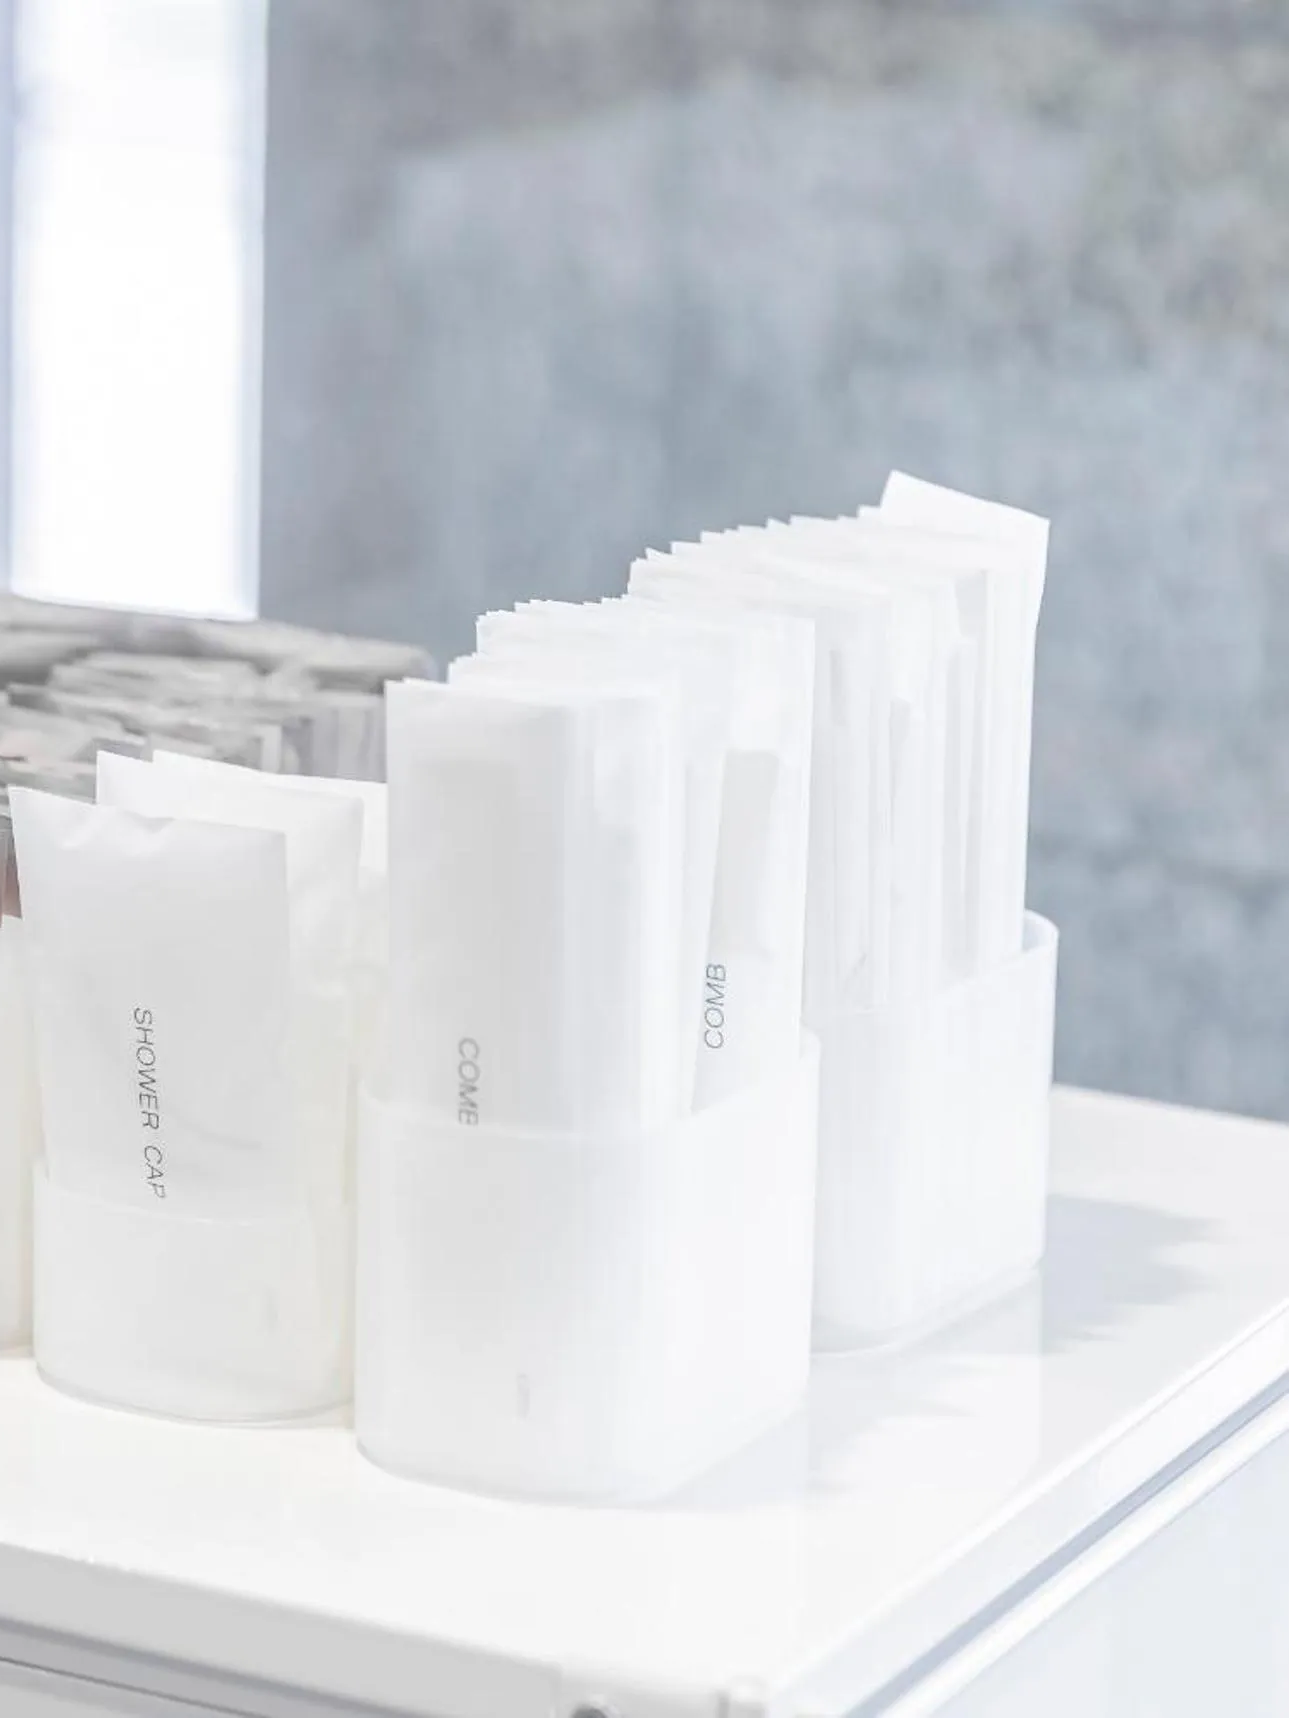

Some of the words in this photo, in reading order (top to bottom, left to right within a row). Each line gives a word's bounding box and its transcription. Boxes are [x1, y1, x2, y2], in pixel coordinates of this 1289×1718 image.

[704, 964, 726, 1048] COMB
[133, 1007, 159, 1130] SHOWER
[144, 1145, 167, 1199] CAP
